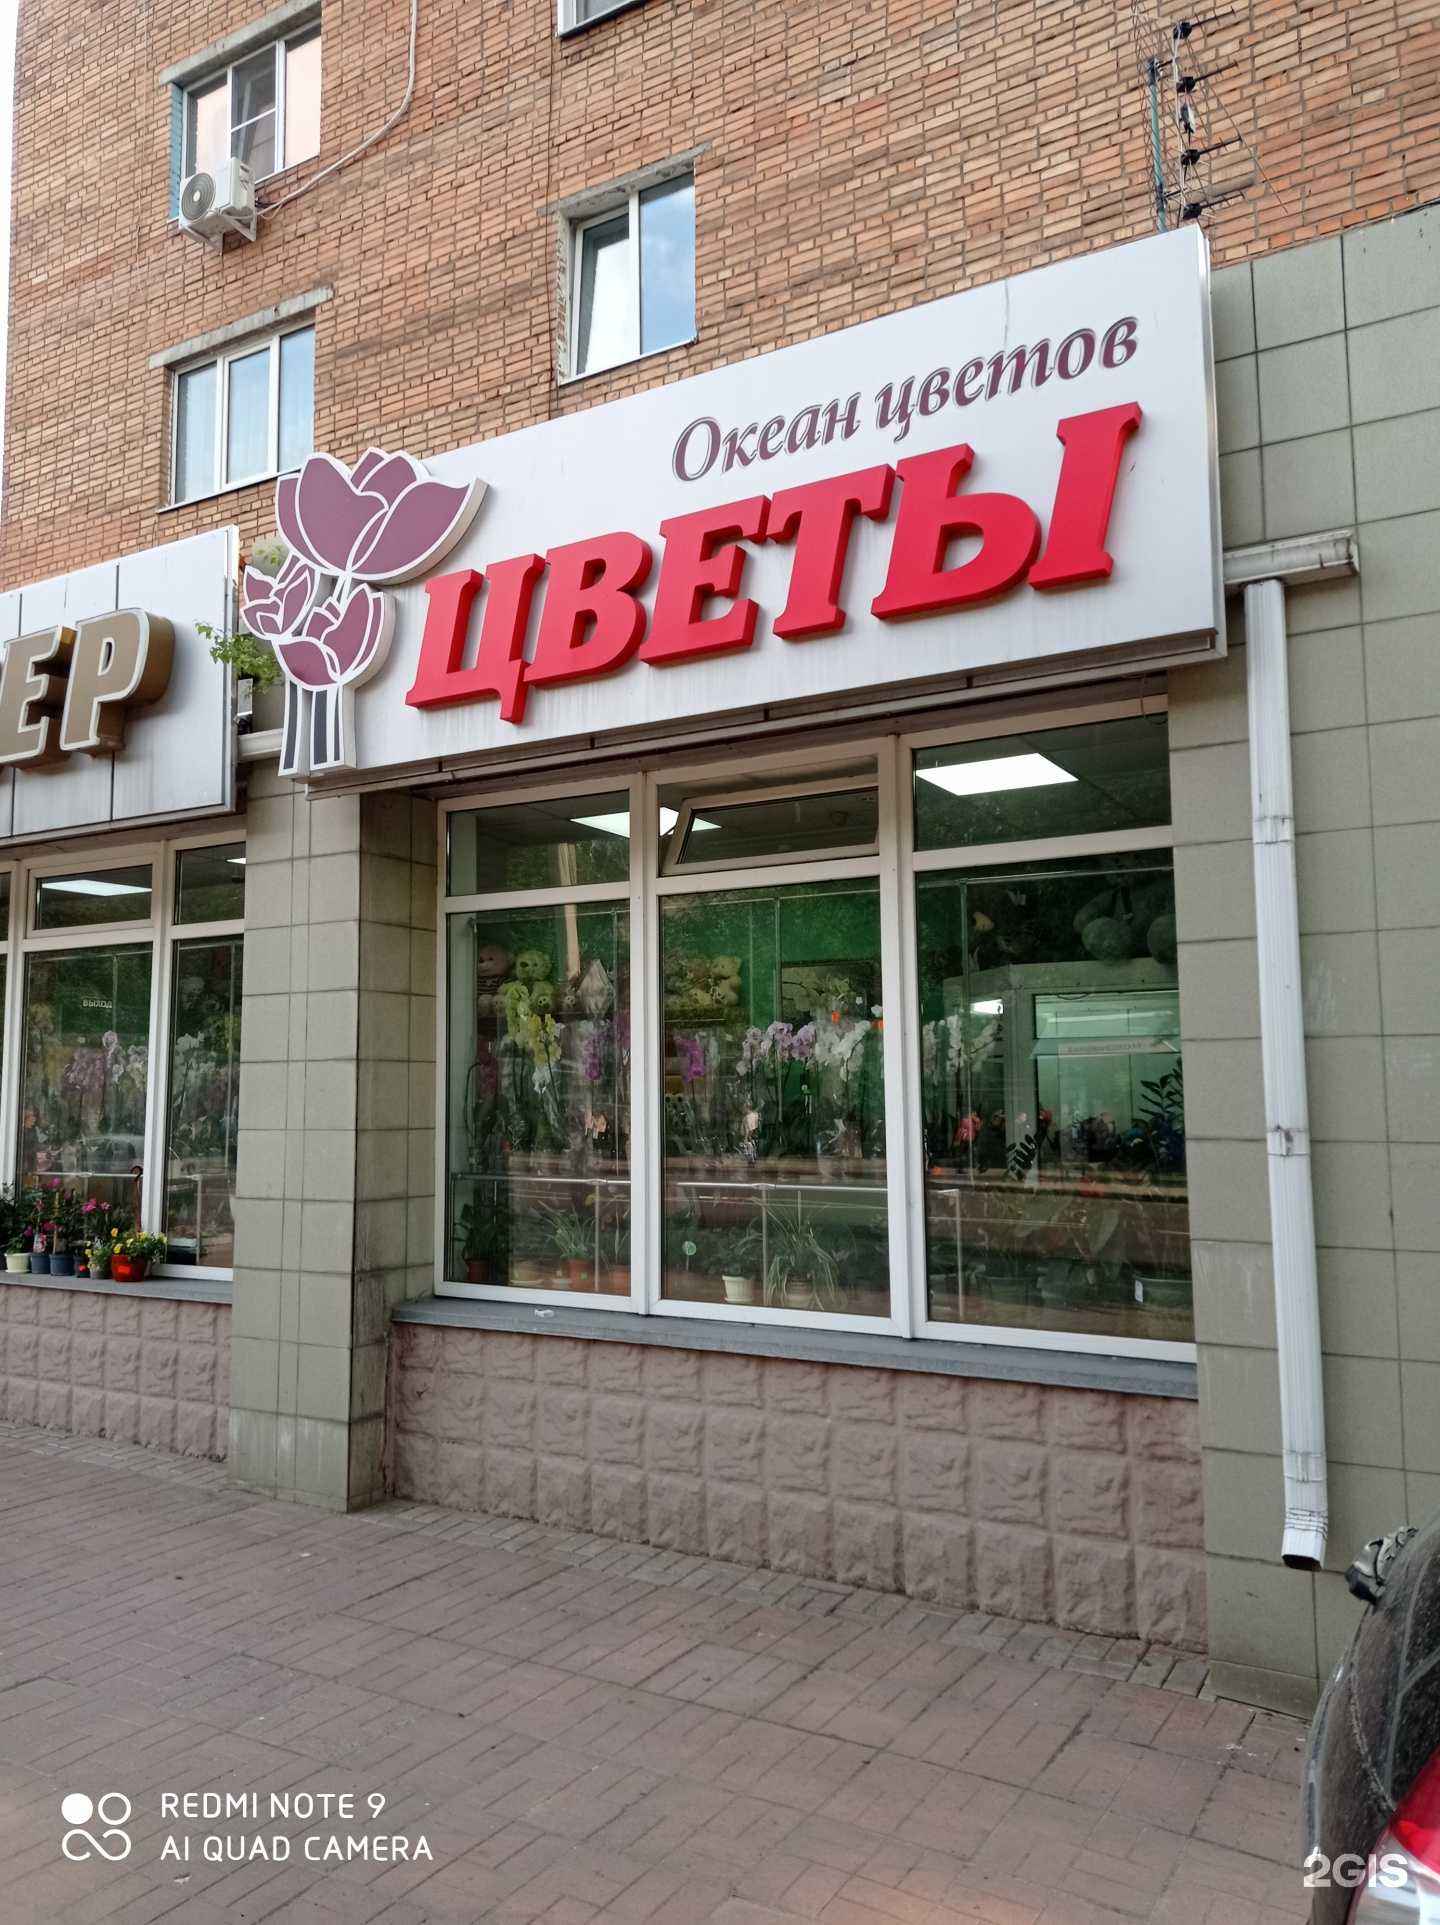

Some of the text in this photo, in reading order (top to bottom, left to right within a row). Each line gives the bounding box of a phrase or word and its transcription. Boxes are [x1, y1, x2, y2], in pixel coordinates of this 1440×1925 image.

[673, 315, 1139, 483] Океан цветов
[406, 402, 1142, 724] ЦВЕТЫ
